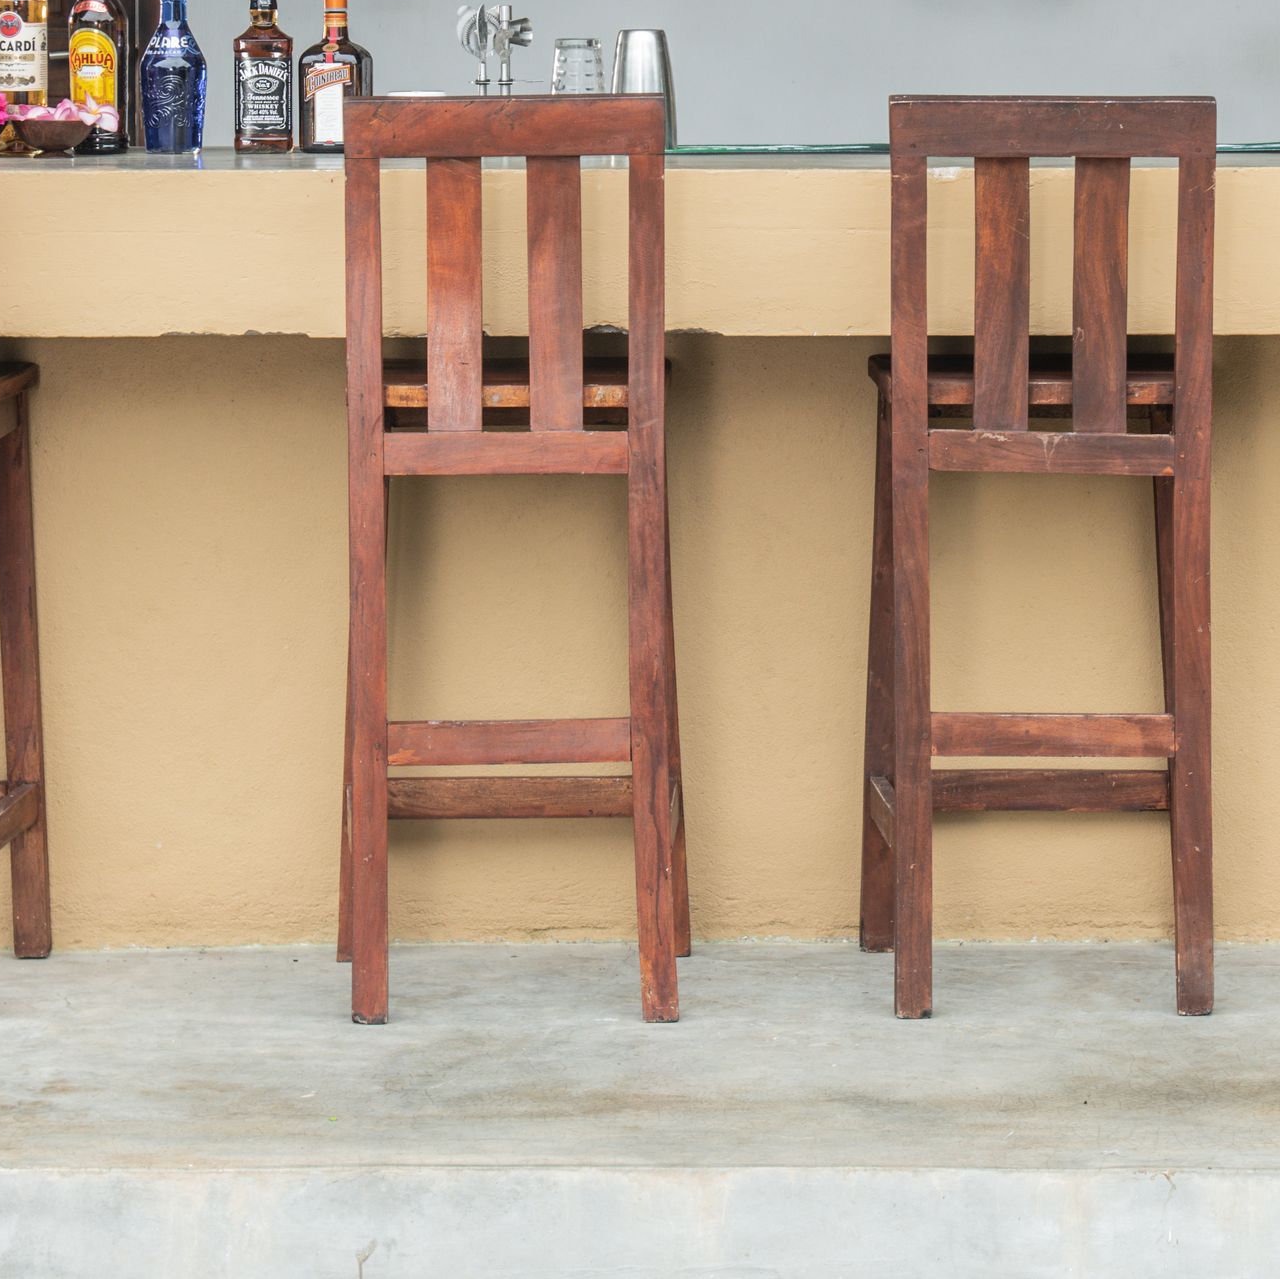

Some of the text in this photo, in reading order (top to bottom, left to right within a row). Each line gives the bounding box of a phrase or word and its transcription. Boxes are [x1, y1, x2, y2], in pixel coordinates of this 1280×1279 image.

[150, 36, 189, 49] OLARE
[70, 47, 114, 71] KAHLÚA
[239, 62, 289, 81] JACK DANIEL'S
[308, 69, 348, 92] COINTREAU
[246, 93, 280, 101] Tennessee
